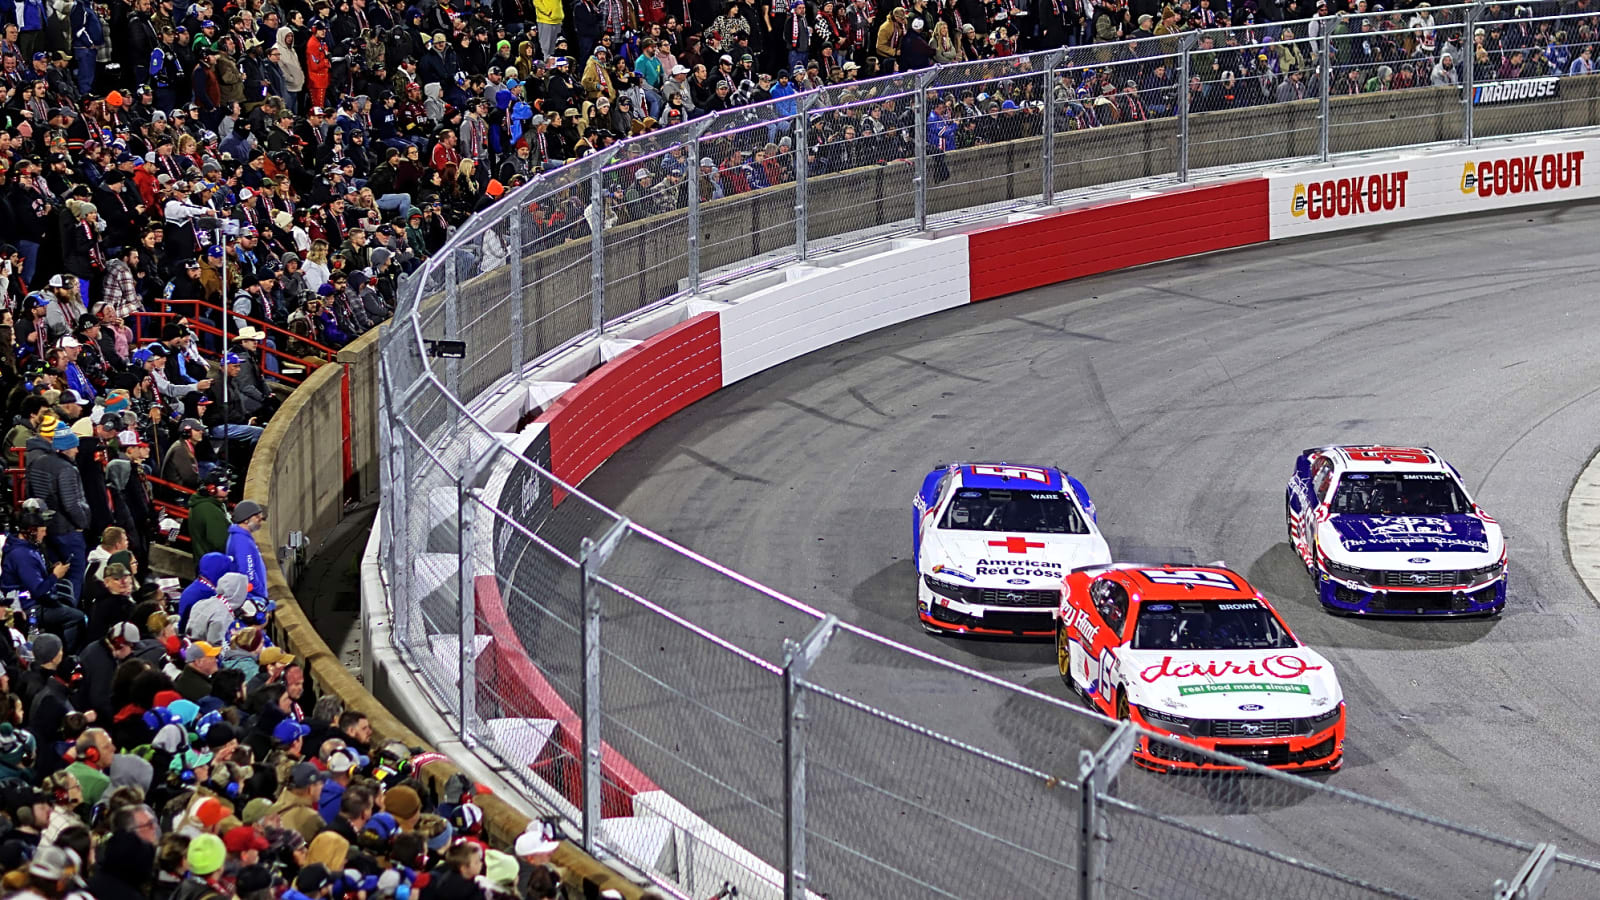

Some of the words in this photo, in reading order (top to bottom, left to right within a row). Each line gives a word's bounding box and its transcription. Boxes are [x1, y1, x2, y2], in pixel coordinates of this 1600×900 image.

[1480, 80, 1556, 103] MADHOUSE
[1478, 156, 1539, 198] COOK
[1541, 151, 1585, 190] OUT
[1308, 176, 1365, 220] COOK
[1367, 171, 1409, 212] OUT
[976, 558, 1062, 569] American
[976, 566, 1009, 576] Red
[1013, 568, 1063, 579] Cross
[1218, 603, 1257, 611] BROWN
[1074, 608, 1101, 645] Hunt
[1098, 646, 1116, 704] 15
[1183, 684, 1205, 693] real
[1207, 683, 1231, 692] food
[1233, 683, 1263, 691] made
[1265, 682, 1302, 693] simple
